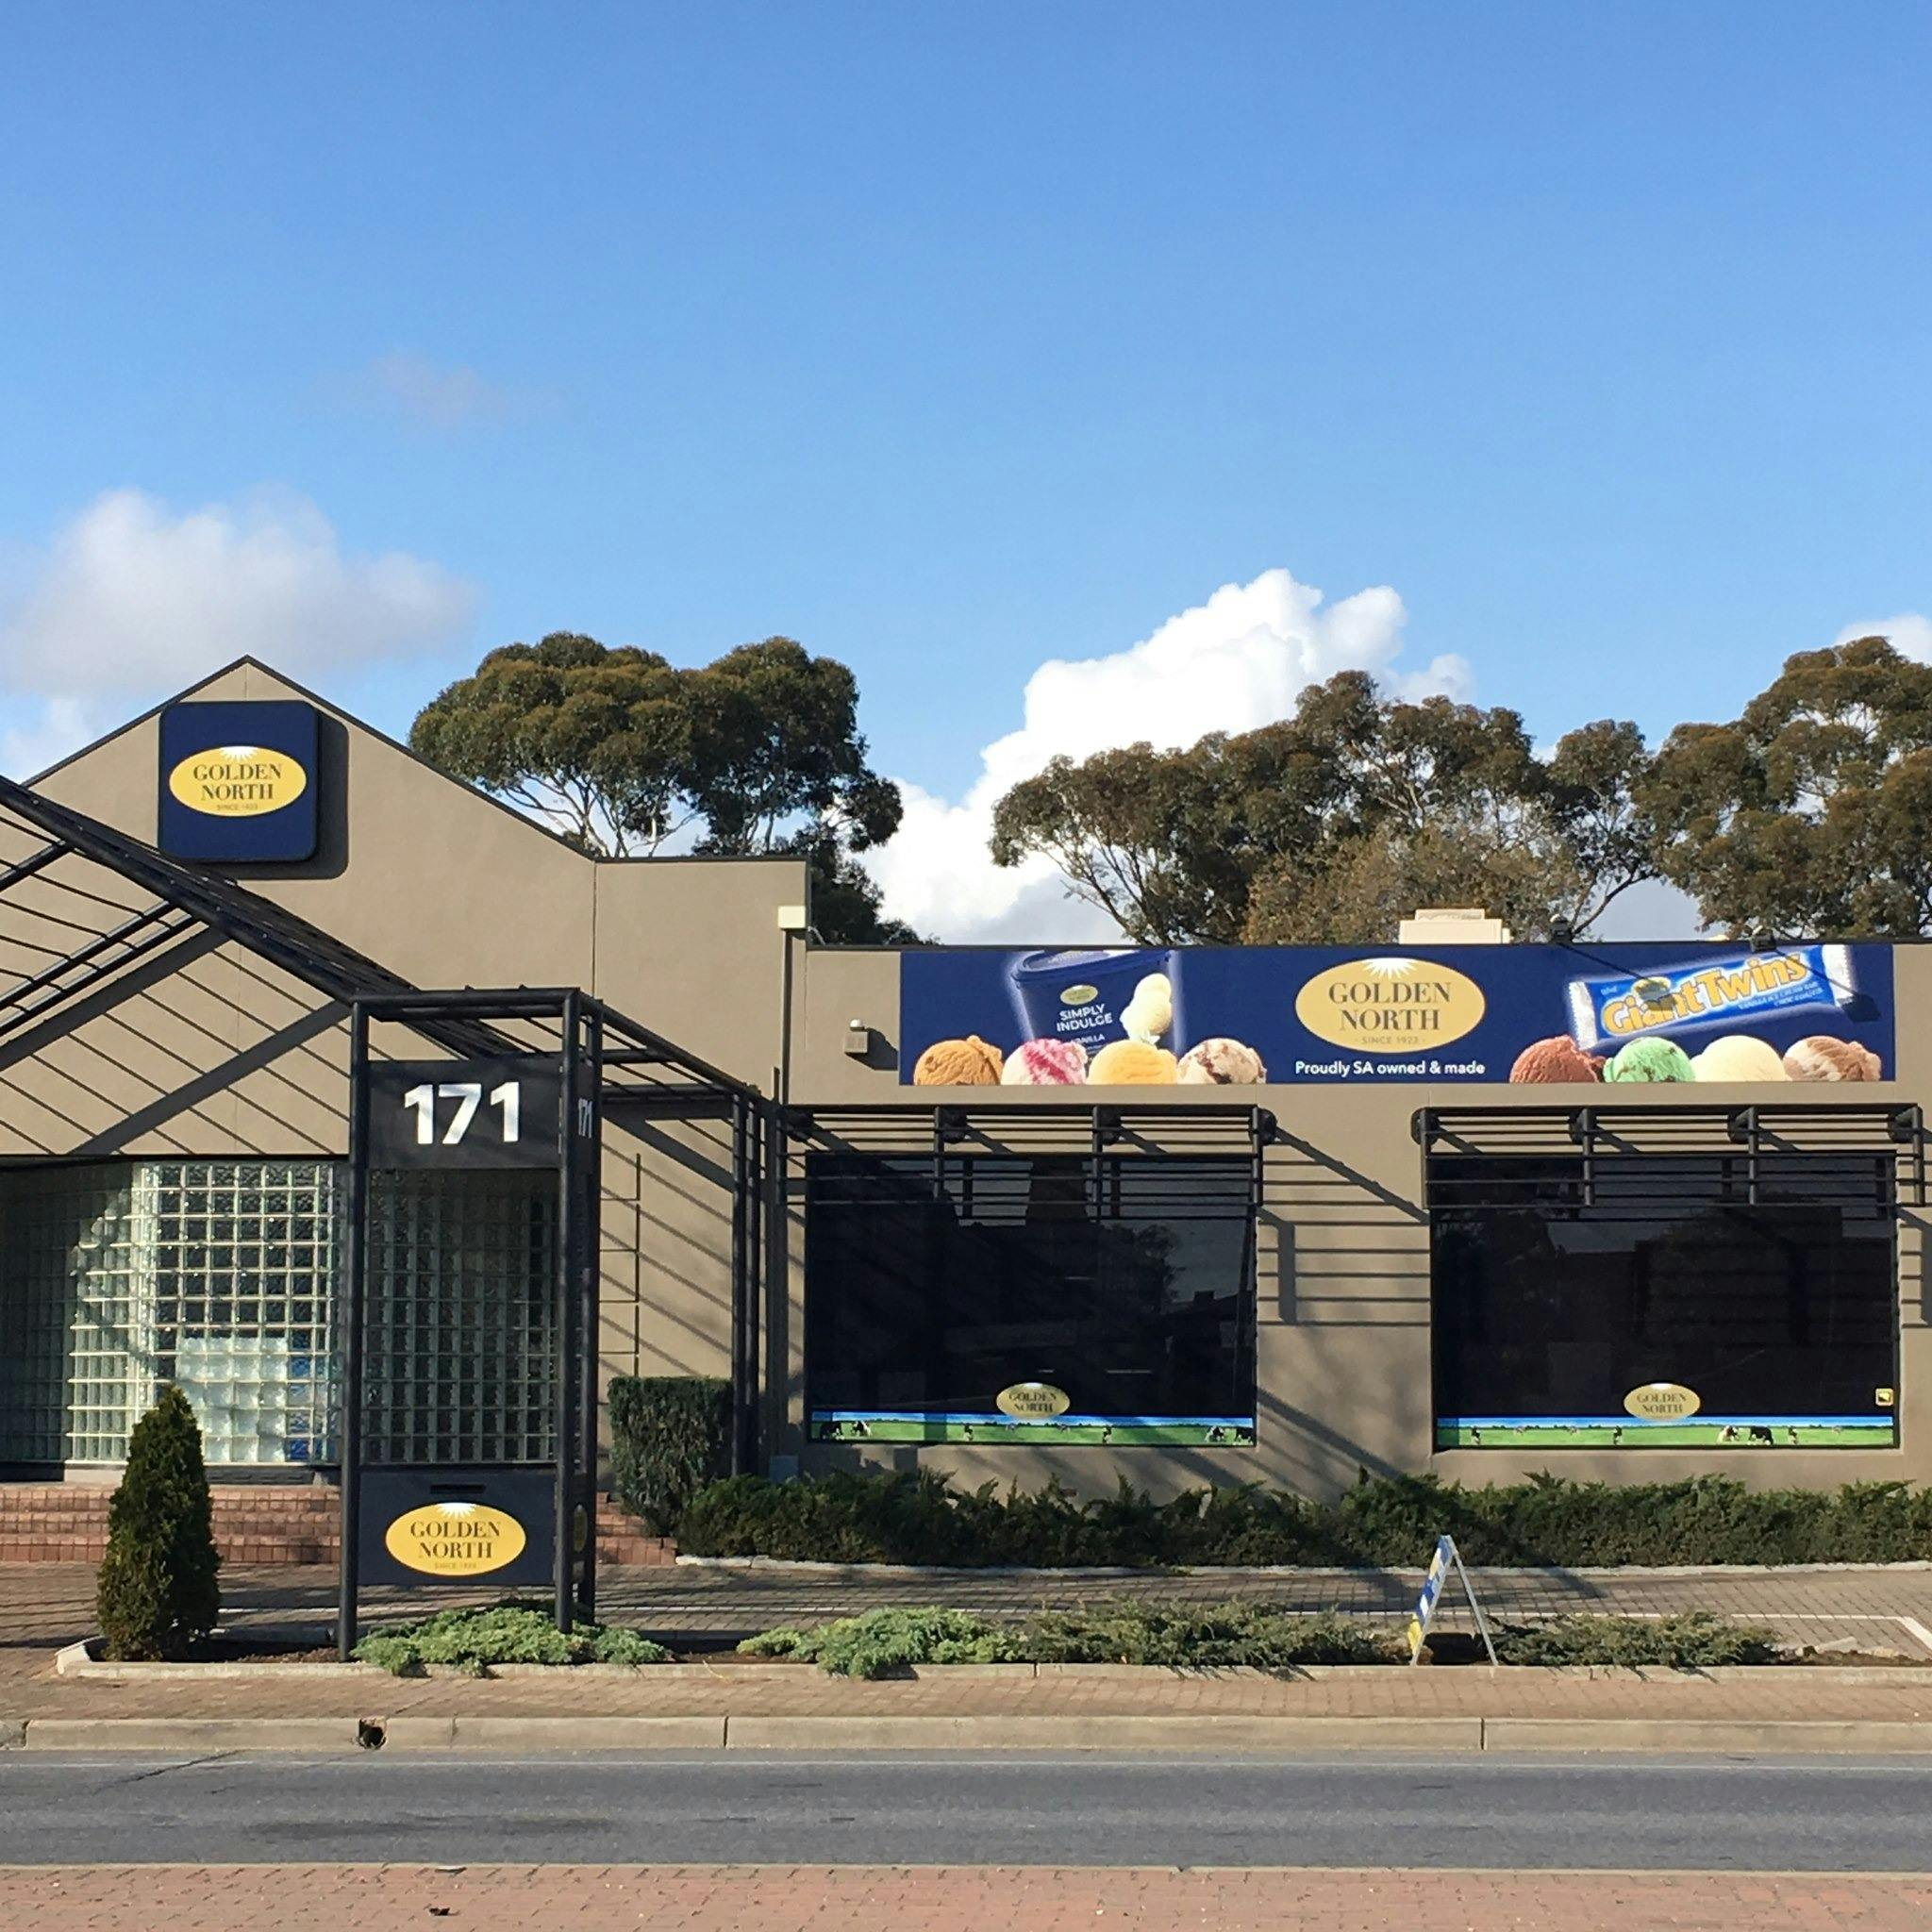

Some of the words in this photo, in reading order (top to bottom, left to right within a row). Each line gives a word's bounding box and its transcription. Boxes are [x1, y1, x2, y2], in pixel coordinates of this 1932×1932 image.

[192, 763, 282, 781] GOLDEN
[201, 784, 274, 801] NORTH
[1328, 982, 1452, 1004] GOLDEN
[1059, 1003, 1106, 1021] SIMPLY
[1340, 1009, 1441, 1030] NORTH
[1057, 1012, 1113, 1032] INDULGE
[1295, 1060, 1350, 1077] Proudly
[1353, 1061, 1374, 1074] SA
[1377, 1060, 1426, 1074] owned
[1429, 1061, 1441, 1074] &
[1444, 1060, 1486, 1074] made
[404, 1081, 519, 1144] 171
[1008, 1392, 1057, 1402] GOLDEN
[1637, 1393, 1687, 1403] GOLDEN
[1014, 1403, 1054, 1412] NORTH
[1642, 1404, 1683, 1413] NORTH
[410, 1521, 501, 1538] GOLDEN
[419, 1542, 492, 1558] NORTH
